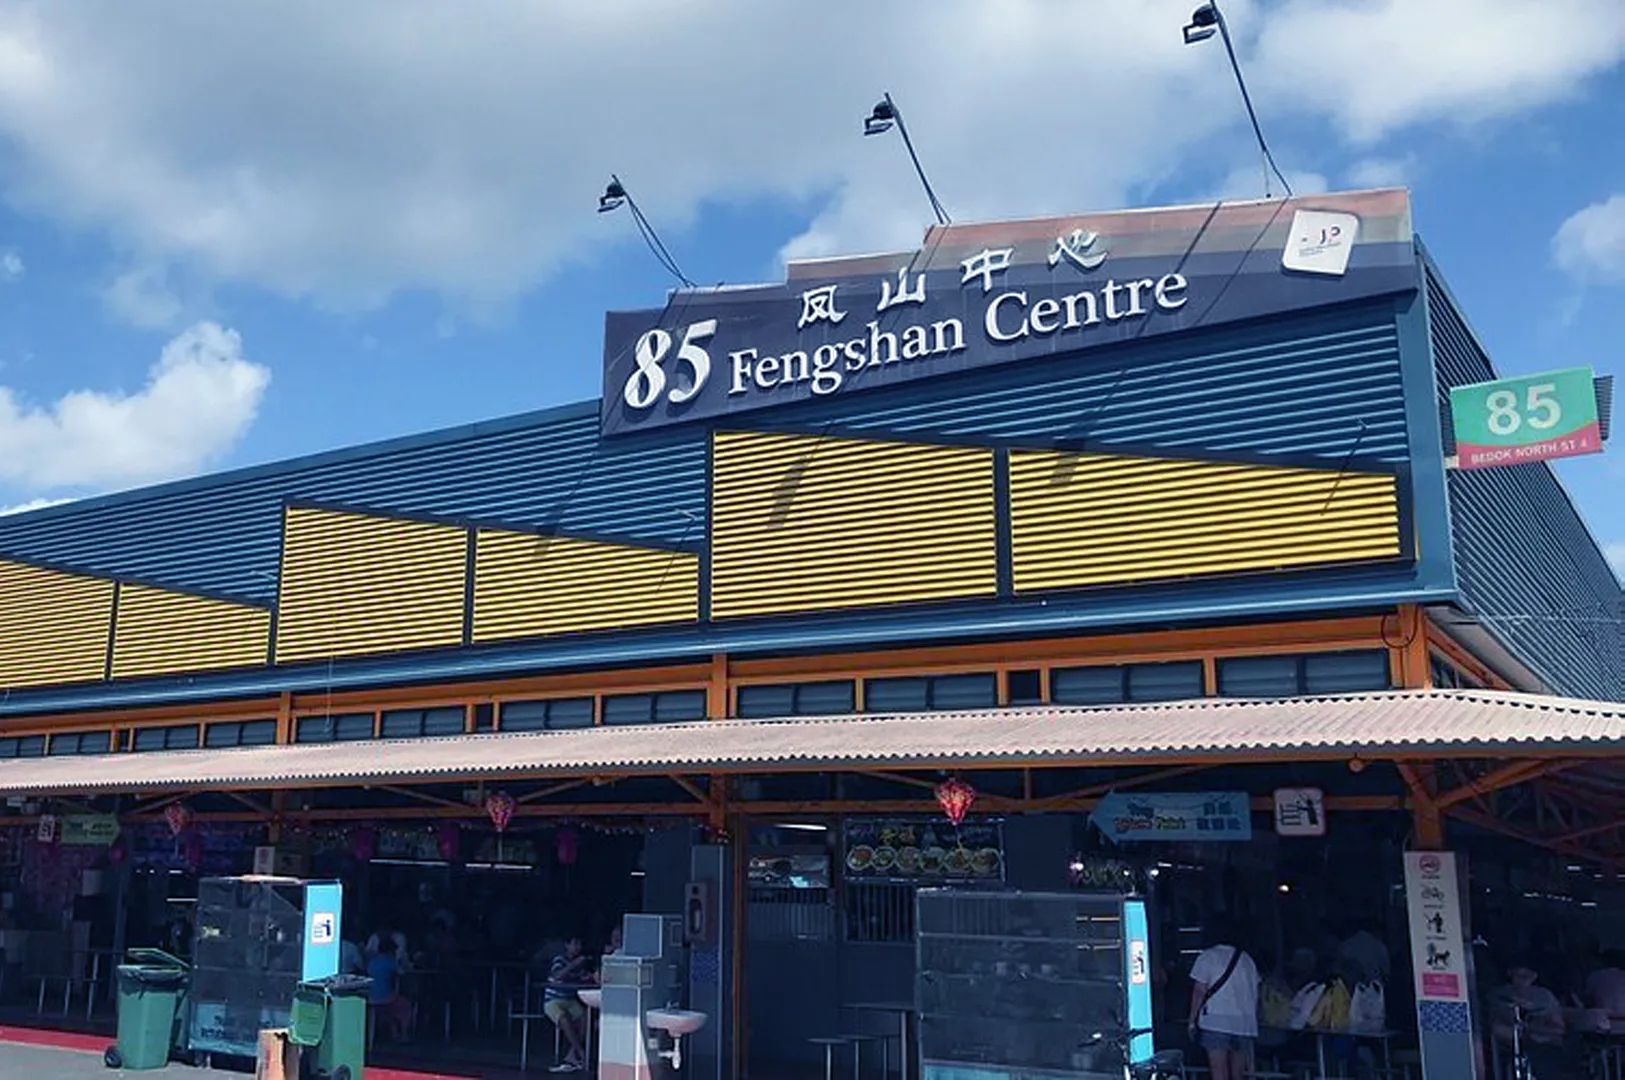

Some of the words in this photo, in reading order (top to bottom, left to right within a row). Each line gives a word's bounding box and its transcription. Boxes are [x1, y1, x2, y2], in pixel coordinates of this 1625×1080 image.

[797, 228, 1107, 329] 凤山中心
[624, 319, 718, 408] 85
[727, 317, 966, 395] Fengshan
[985, 273, 1188, 341] Centre
[1486, 383, 1561, 436] 85
[1471, 448, 1513, 463] BEDOK
[1515, 441, 1557, 457] NORTH
[1560, 439, 1576, 451] ST
